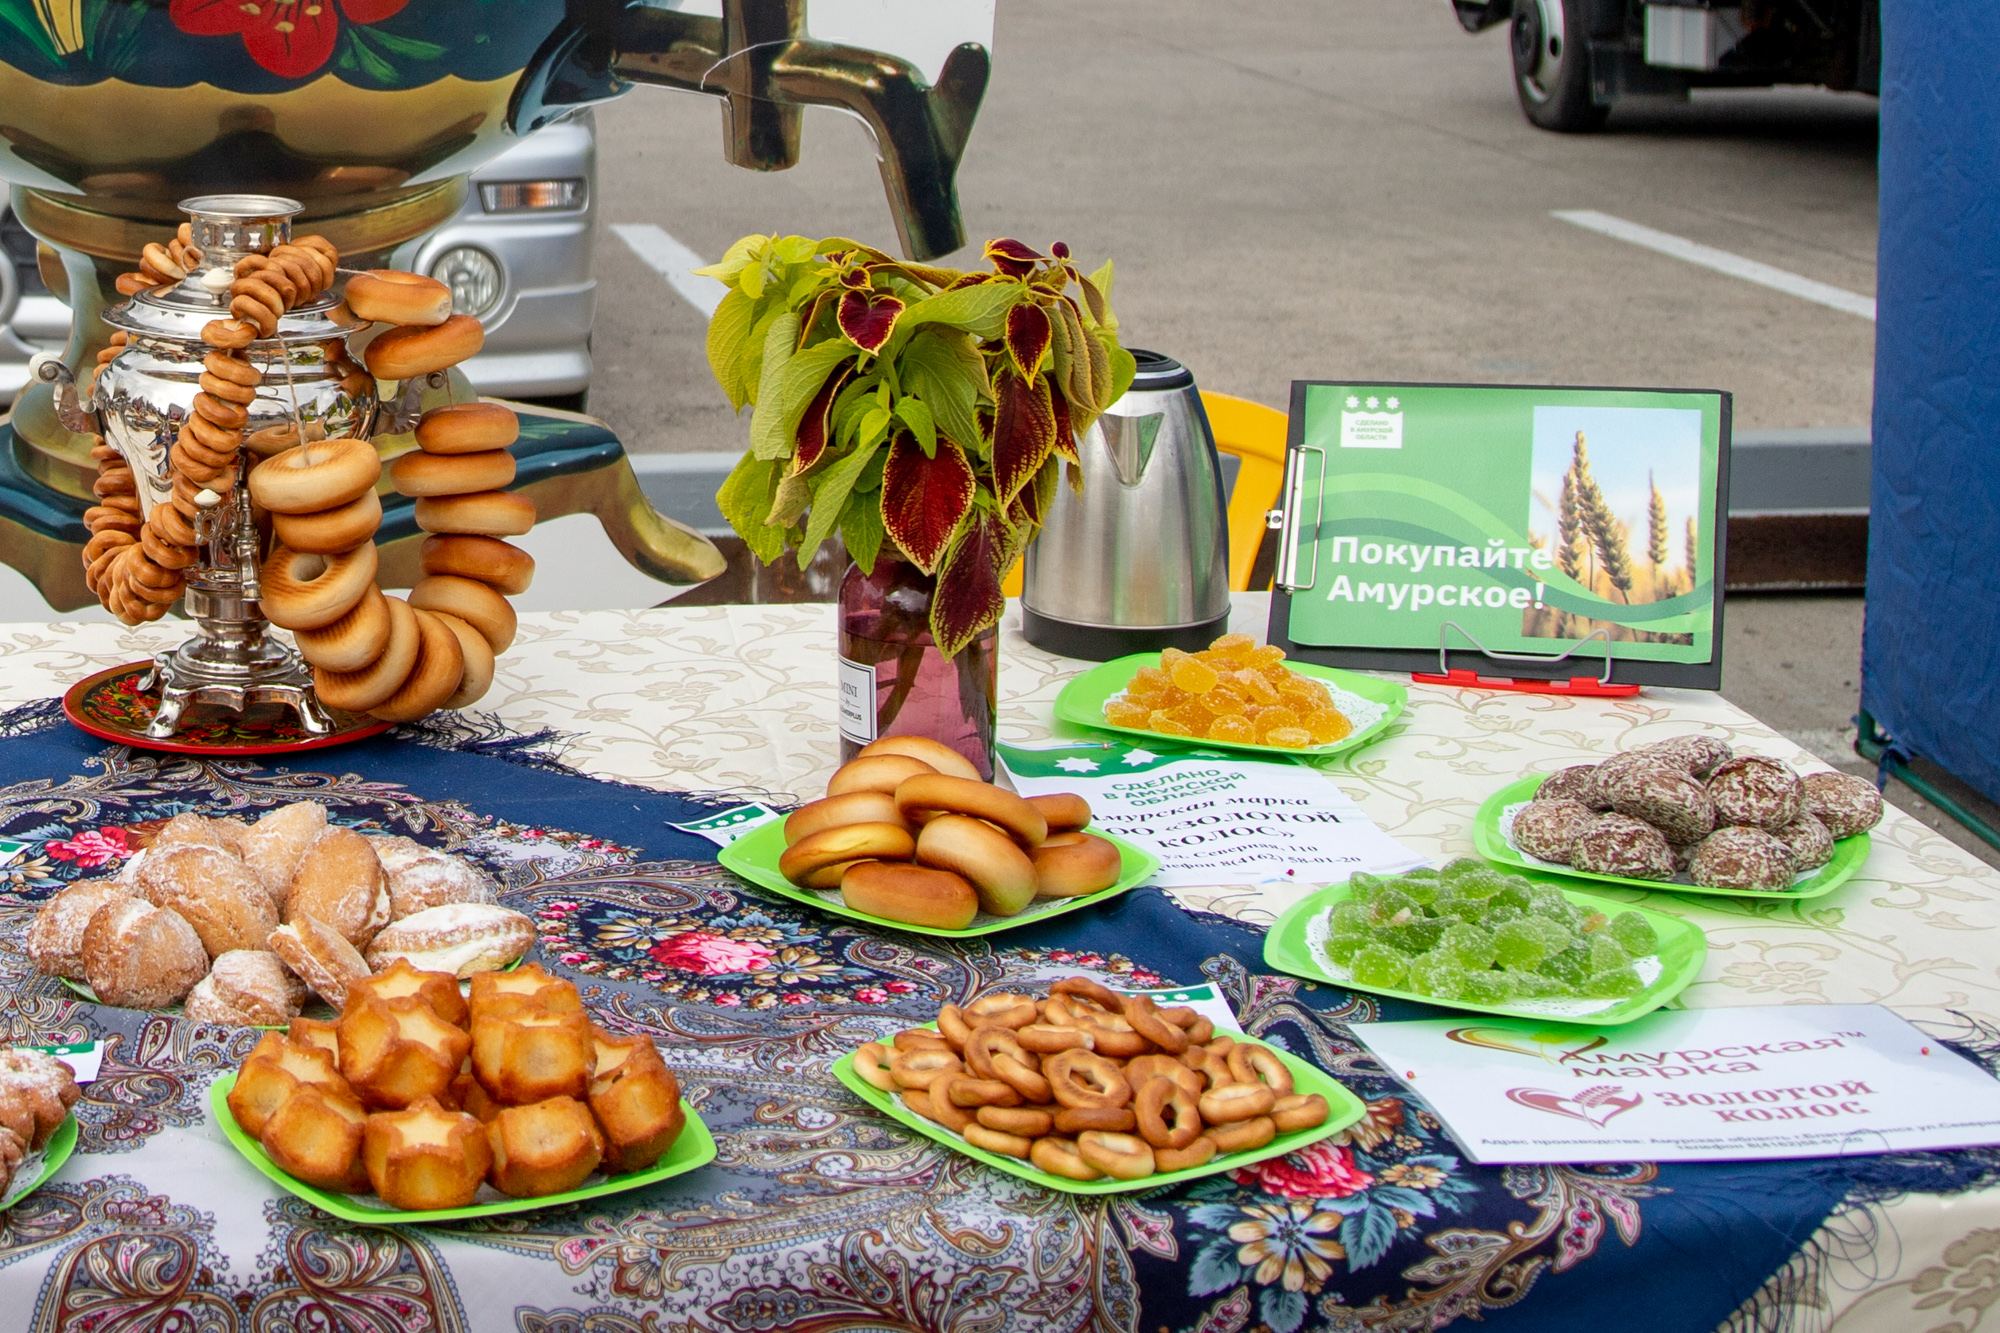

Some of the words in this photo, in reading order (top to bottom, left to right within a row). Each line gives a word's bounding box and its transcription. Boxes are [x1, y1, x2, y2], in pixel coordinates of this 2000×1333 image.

[1331, 536, 1554, 573] Покупайте
[1326, 574, 1545, 612] Амурское!
[1102, 792, 1119, 800] В
[1125, 772, 1248, 799] АМУРСКОЙ
[1111, 769, 1221, 791] СДЕЛАНО
[1130, 783, 1238, 807] ОБЛАСТИ
[1225, 797, 1310, 806] марка
[1165, 811, 1342, 832] «ЗОЛОТОЙ
[1157, 826, 1295, 848] КОЛОС»
[1288, 856, 1361, 864] 58-01-20
[1559, 1036, 1846, 1066] Амурская
[1572, 1060, 1761, 1079] марка
